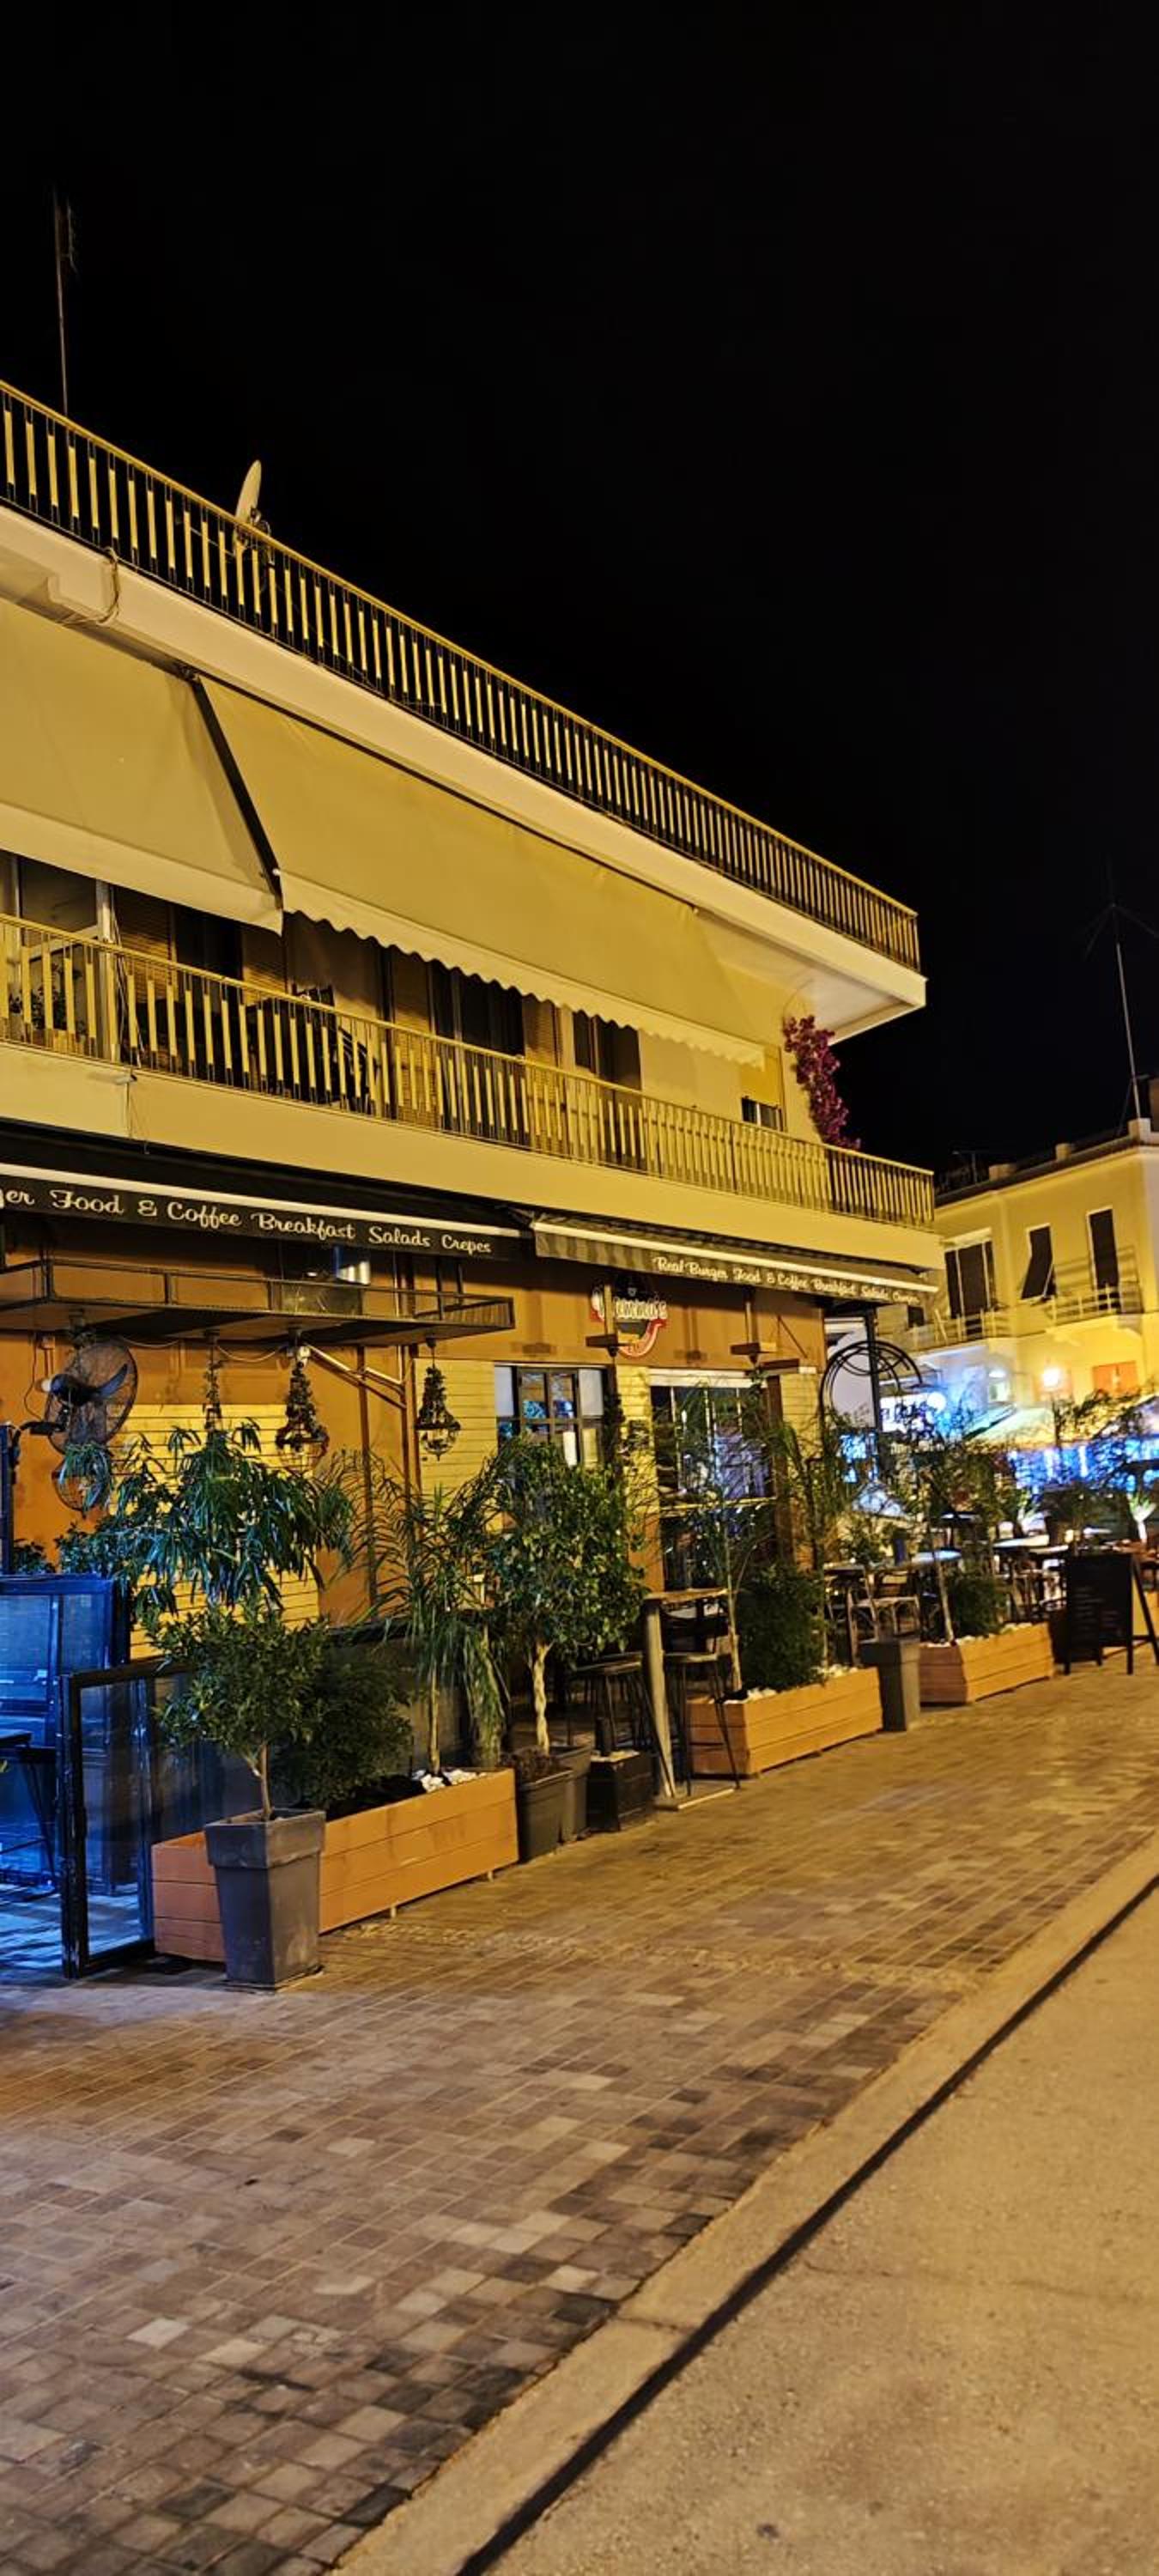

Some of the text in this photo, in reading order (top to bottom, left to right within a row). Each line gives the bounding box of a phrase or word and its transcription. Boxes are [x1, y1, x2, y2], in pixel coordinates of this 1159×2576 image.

[49, 1189, 124, 1215] Food
[137, 1200, 158, 1217] &
[167, 1201, 242, 1230] Coffee
[251, 1212, 356, 1240] Breakfast
[368, 1226, 431, 1248] Salads
[441, 1234, 492, 1255] Crepes
[652, 1257, 684, 1273] Real
[685, 1261, 728, 1282] Burger
[732, 1267, 762, 1284] Food
[777, 1273, 808, 1291] Coffee
